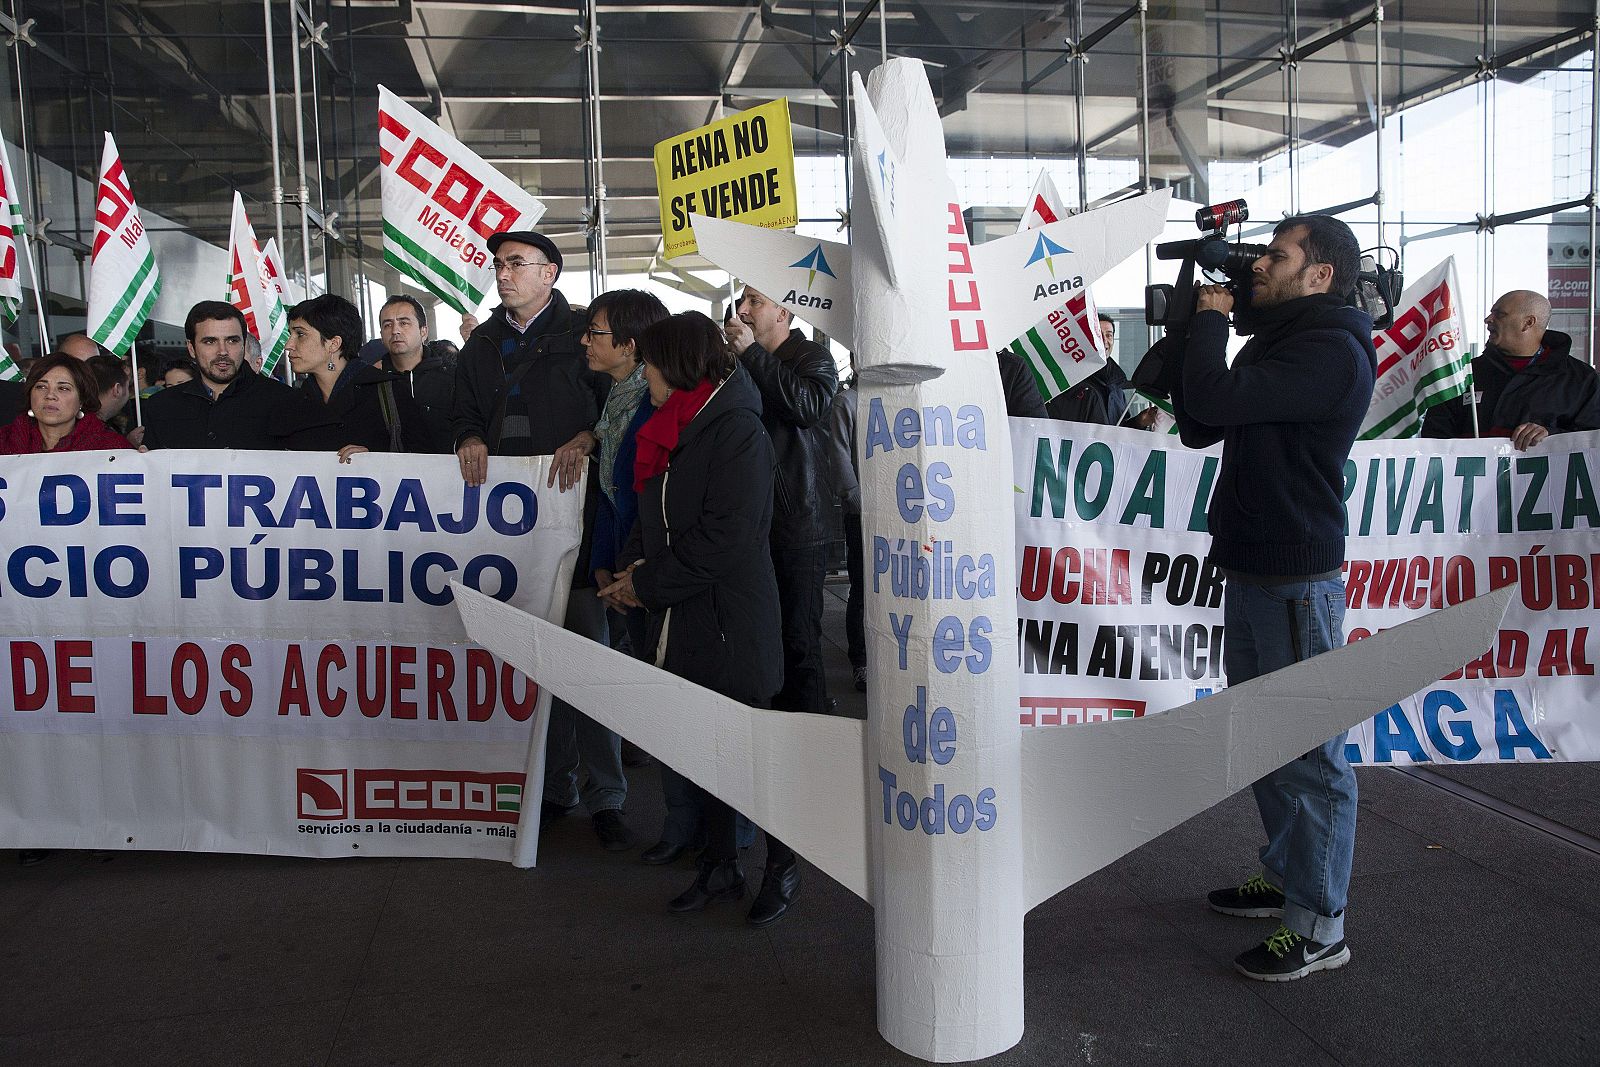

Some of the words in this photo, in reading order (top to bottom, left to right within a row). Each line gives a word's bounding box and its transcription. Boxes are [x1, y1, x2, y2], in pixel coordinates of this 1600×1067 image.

[671, 128, 730, 181] AENA
[733, 115, 769, 160] NO
[701, 168, 781, 219] VENDE
[417, 204, 488, 269] Málaga
[782, 289, 833, 311] Aena
[1033, 275, 1084, 301] Aena
[865, 396, 987, 460] Aena
[38, 473, 147, 527] DE
[171, 474, 539, 537] TRABAJO
[896, 461, 956, 524] es
[1030, 437, 1115, 522] NO
[1119, 449, 1167, 529] A
[178, 534, 519, 606] PÚBLICO
[873, 535, 996, 600] Pública
[1017, 545, 1133, 605] UCHA
[1140, 551, 1226, 609] POR
[888, 612, 914, 670] Y
[932, 615, 993, 675] es
[1017, 617, 1079, 676] NA
[1085, 623, 1228, 681] ATENCI
[1537, 626, 1595, 677] AL
[9, 640, 96, 714] DE
[131, 641, 254, 717] LOS
[276, 642, 539, 723] ACUERDO
[903, 686, 957, 766] de
[1343, 689, 1553, 764] AGA
[365, 779, 493, 812] CCOO
[878, 764, 998, 836] Todos
[297, 822, 361, 835] servicios
[365, 824, 374, 833] a
[378, 822, 391, 833] la
[395, 821, 472, 835] ciudadanía
[486, 826, 517, 839] mála
